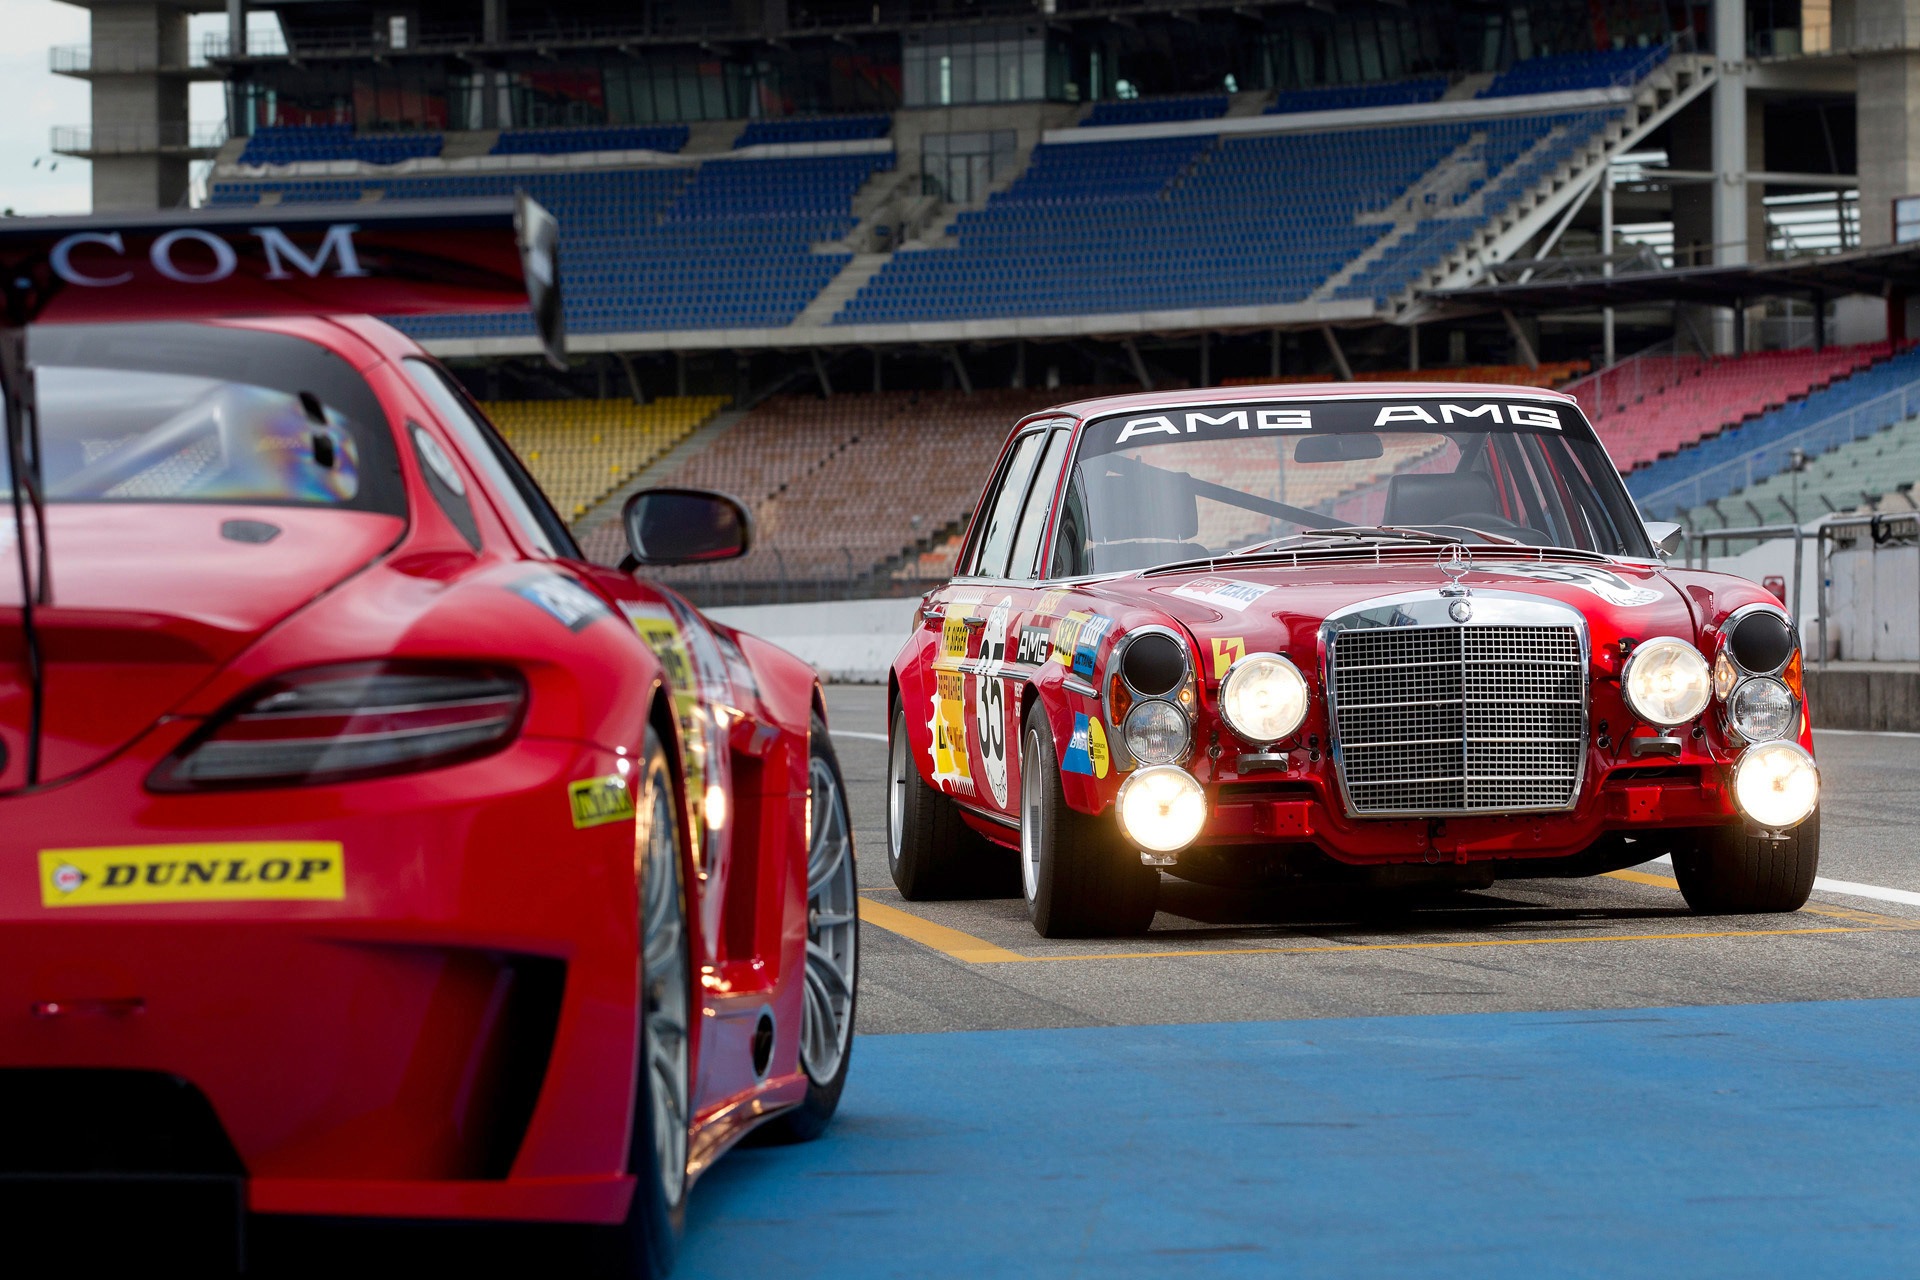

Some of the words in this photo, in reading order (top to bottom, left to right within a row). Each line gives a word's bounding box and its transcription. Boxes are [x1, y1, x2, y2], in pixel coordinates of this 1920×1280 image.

[48, 223, 370, 287] COM
[1115, 409, 1312, 444] AMG
[1374, 404, 1562, 431] AMG
[1215, 585, 1264, 602] JEANS
[1017, 631, 1049, 663] AMG
[978, 639, 1005, 761] 35
[99, 858, 332, 889] DUNLOP
